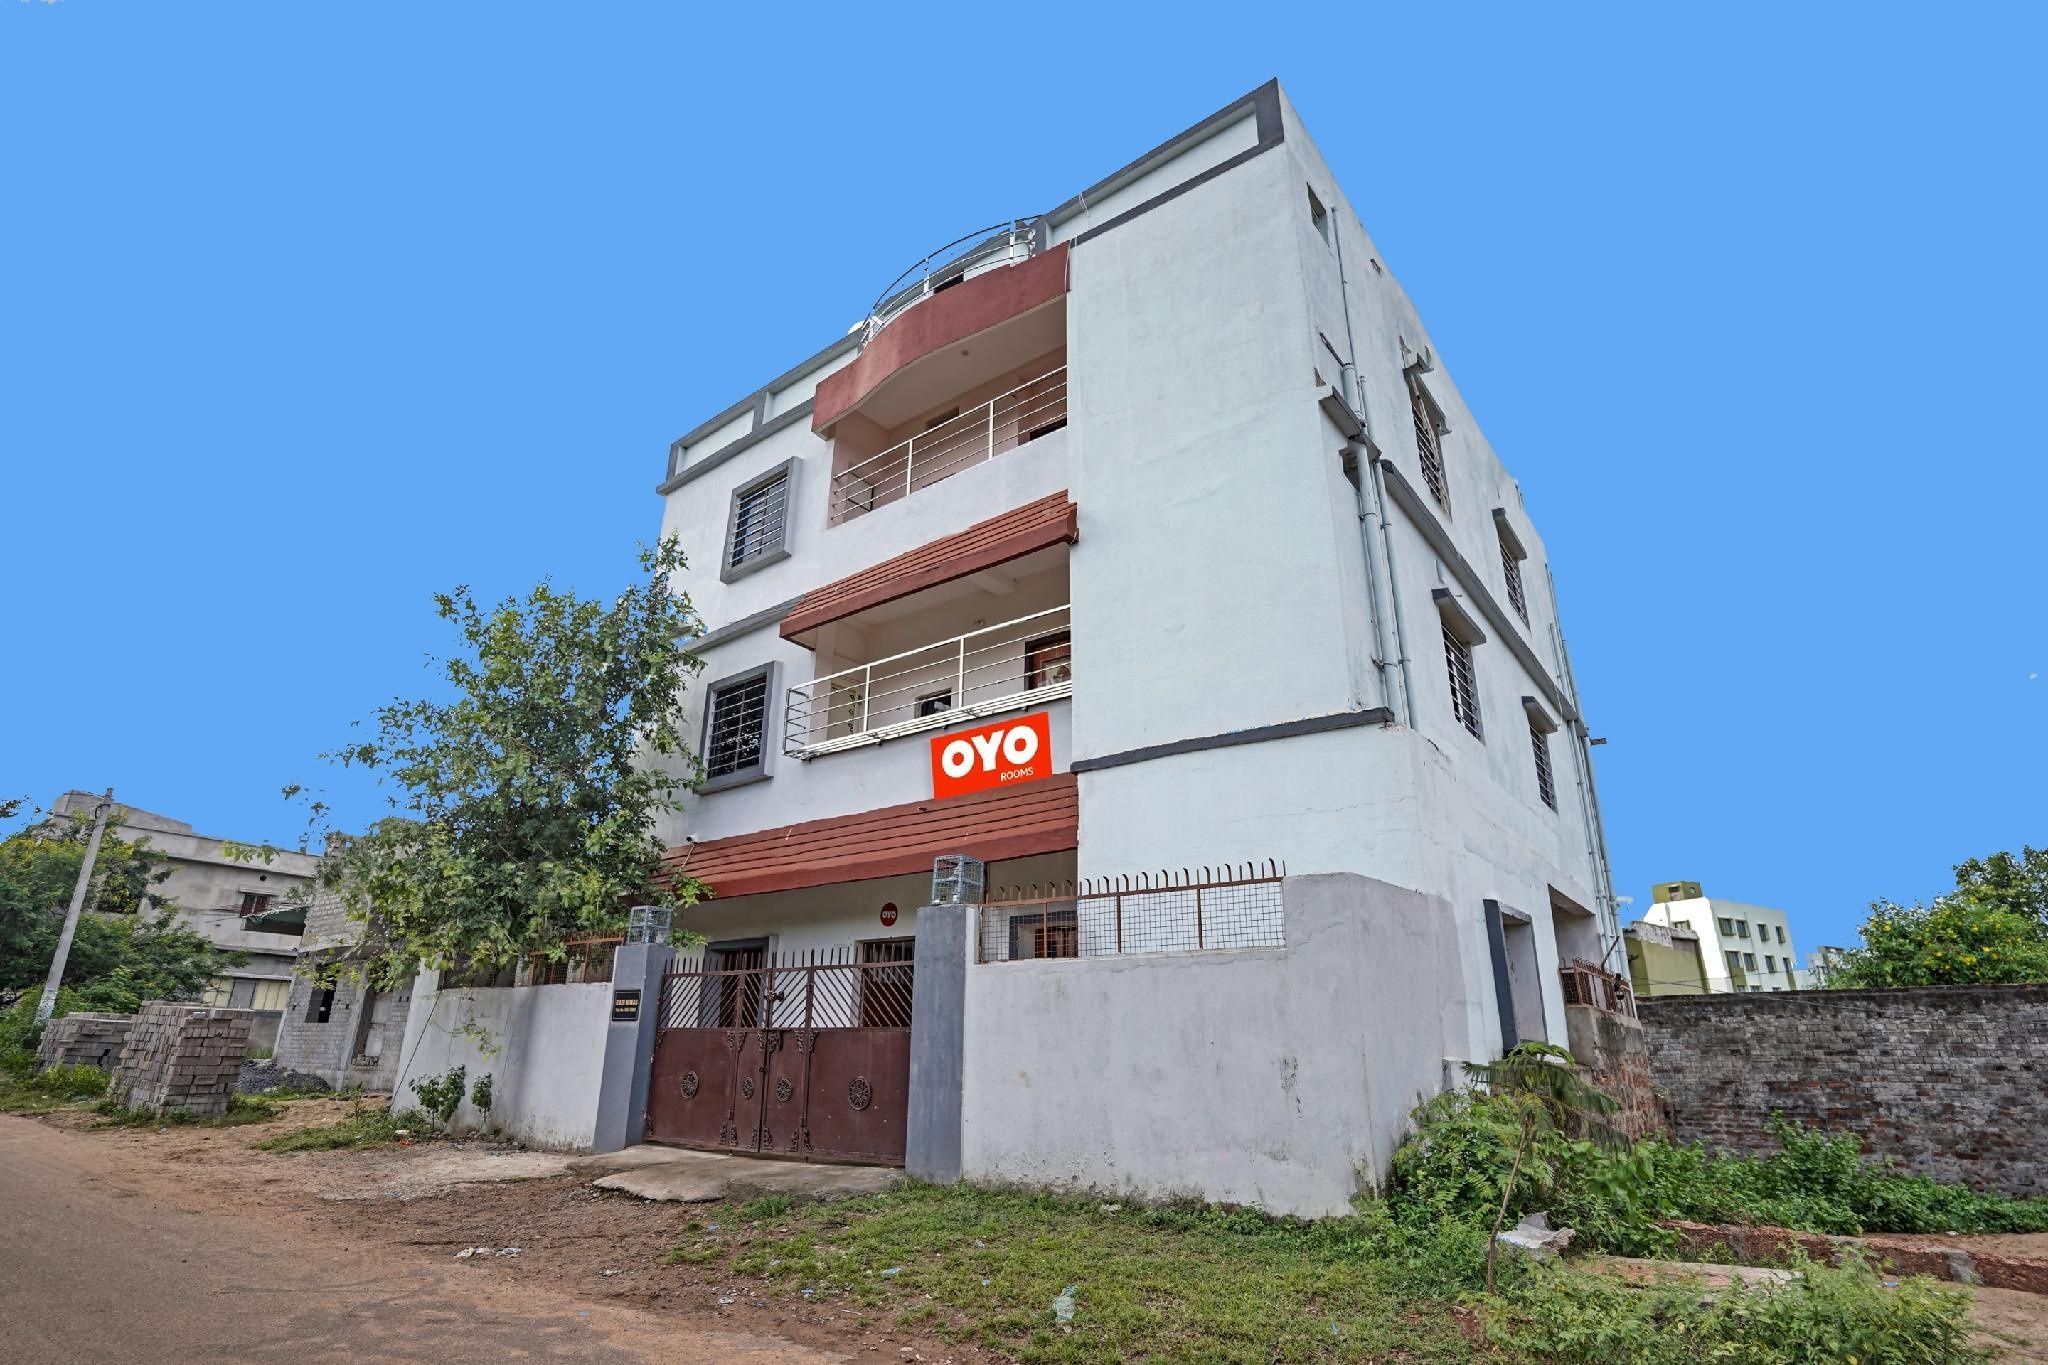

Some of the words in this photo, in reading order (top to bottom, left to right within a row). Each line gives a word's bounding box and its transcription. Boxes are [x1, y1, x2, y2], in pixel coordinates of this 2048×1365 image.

[942, 725, 1038, 778] OYO
[1000, 767, 1033, 781] ROOMS
[882, 911, 896, 919] OYO
